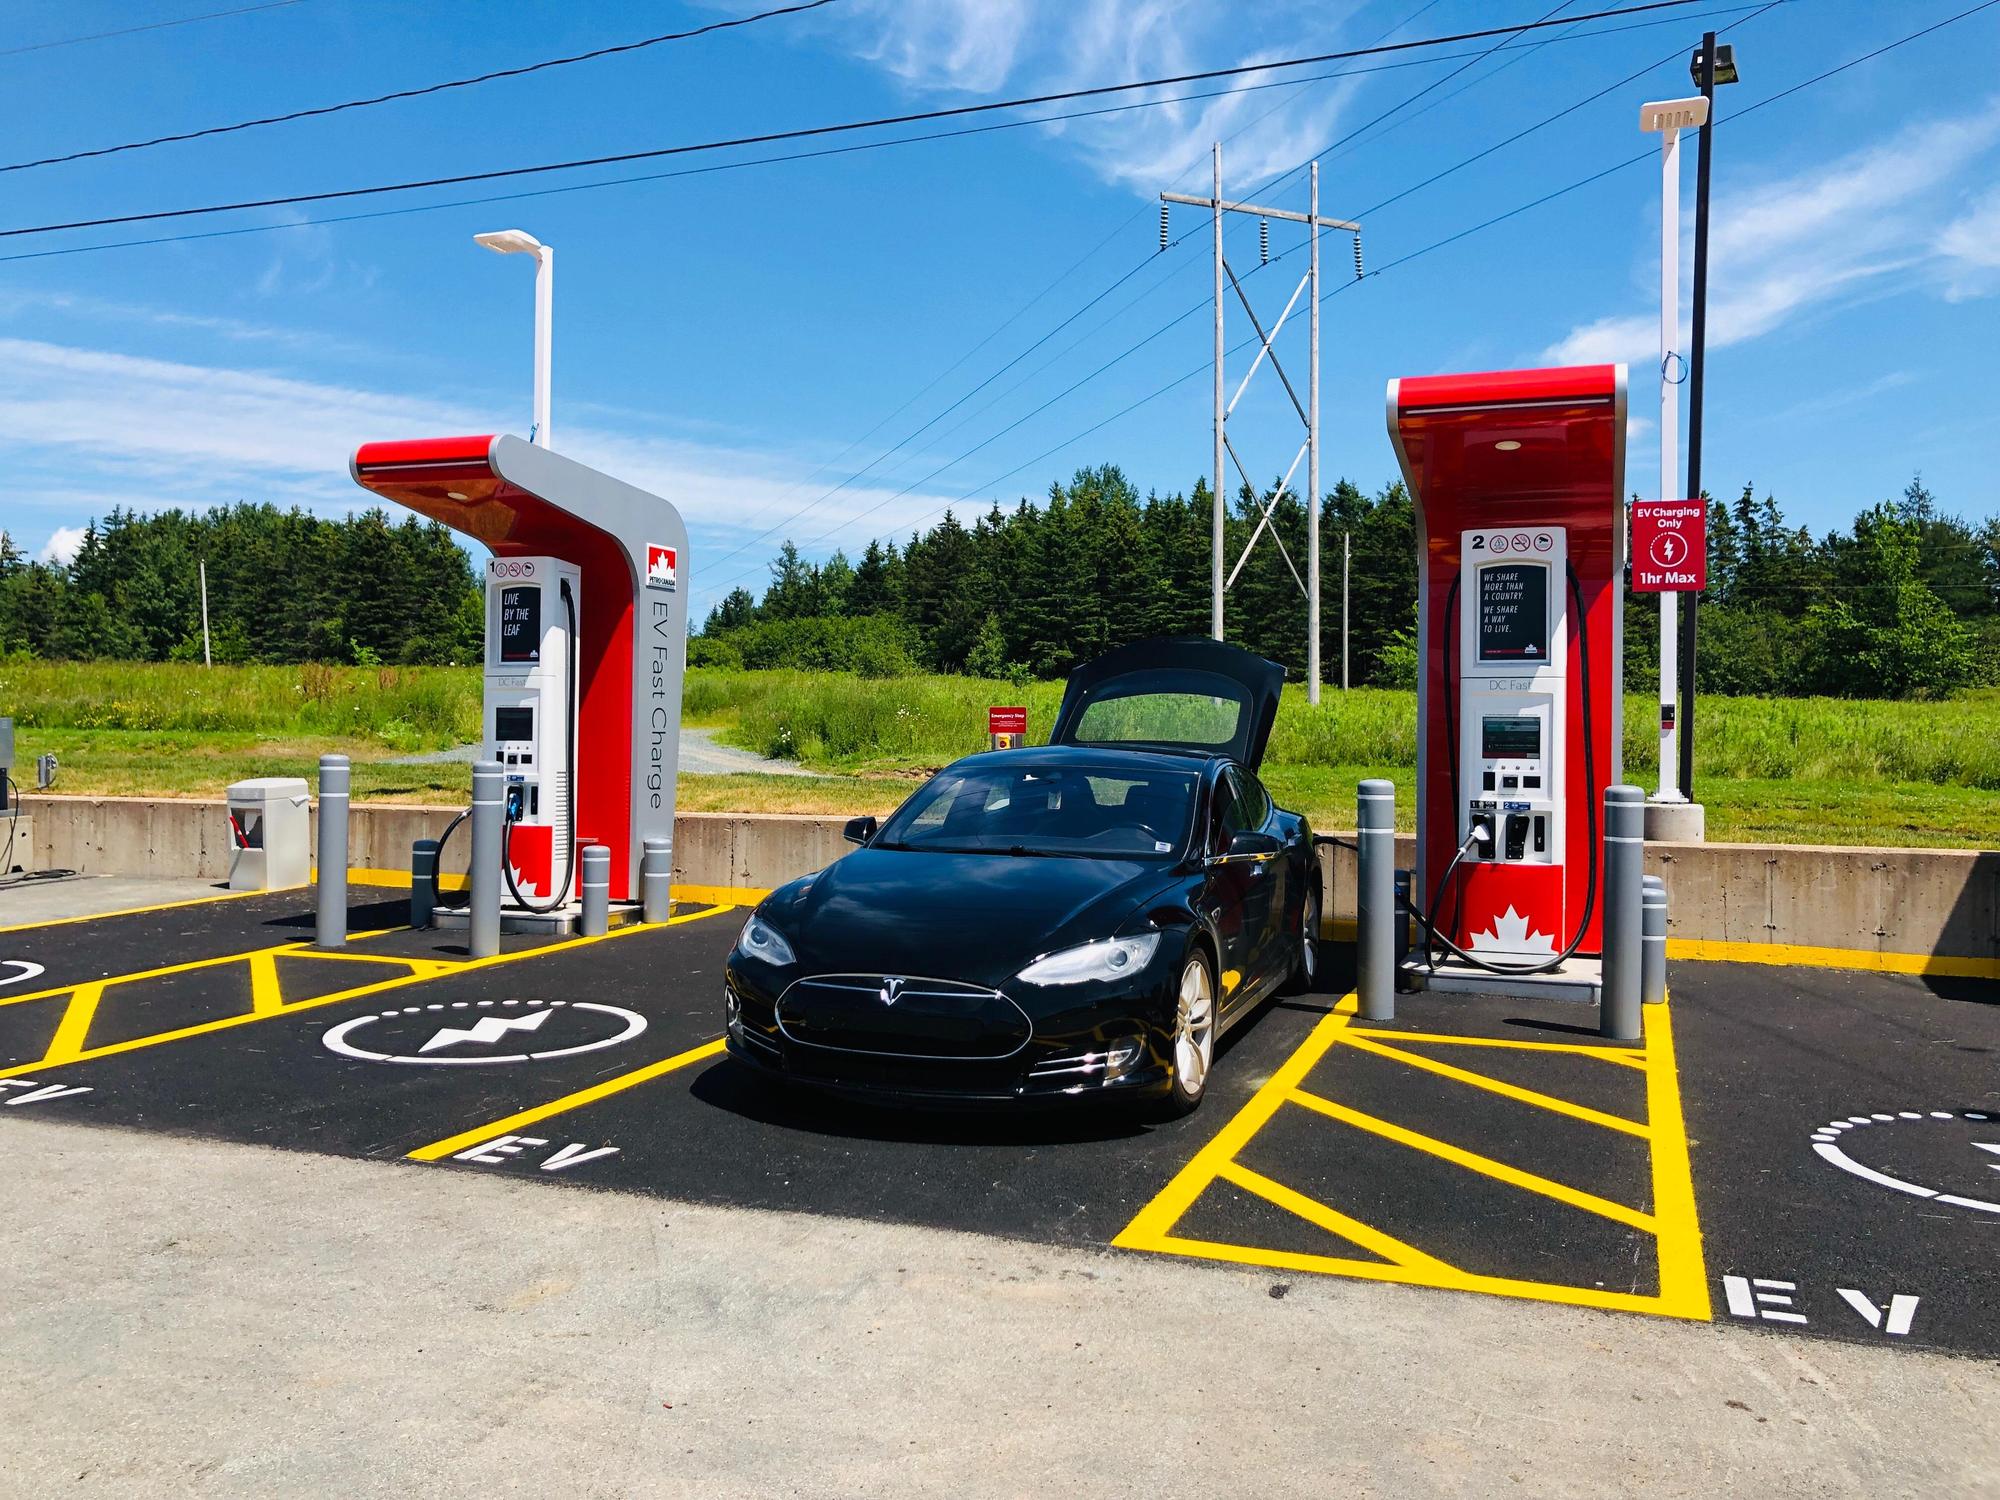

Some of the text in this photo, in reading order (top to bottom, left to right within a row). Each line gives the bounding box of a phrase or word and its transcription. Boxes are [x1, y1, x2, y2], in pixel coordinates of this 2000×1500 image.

[1637, 507, 1700, 518] EV Charging
[1657, 518, 1682, 530] Only
[1472, 535, 1485, 550] 2
[489, 561, 495, 573] 1
[1483, 572, 1519, 582] WE SHARE
[1640, 571, 1697, 585] 1hr Max
[1483, 582, 1524, 591] MORE THAN
[504, 593, 520, 606] LIVE
[1484, 592, 1524, 601] A COUNTRY.
[504, 608, 530, 621] BY THE
[1483, 605, 1519, 614] WE SHARE
[1484, 615, 1506, 623] A WAY
[504, 623, 521, 636] LEAF
[1483, 624, 1512, 633] TO LIVE.
[498, 678, 526, 688] DC Fast
[1489, 680, 1532, 691] DC Fast
[647, 601, 668, 809] EV Fast Charge
[452, 1135, 621, 1171] EV
[1723, 1275, 1921, 1335] EV
